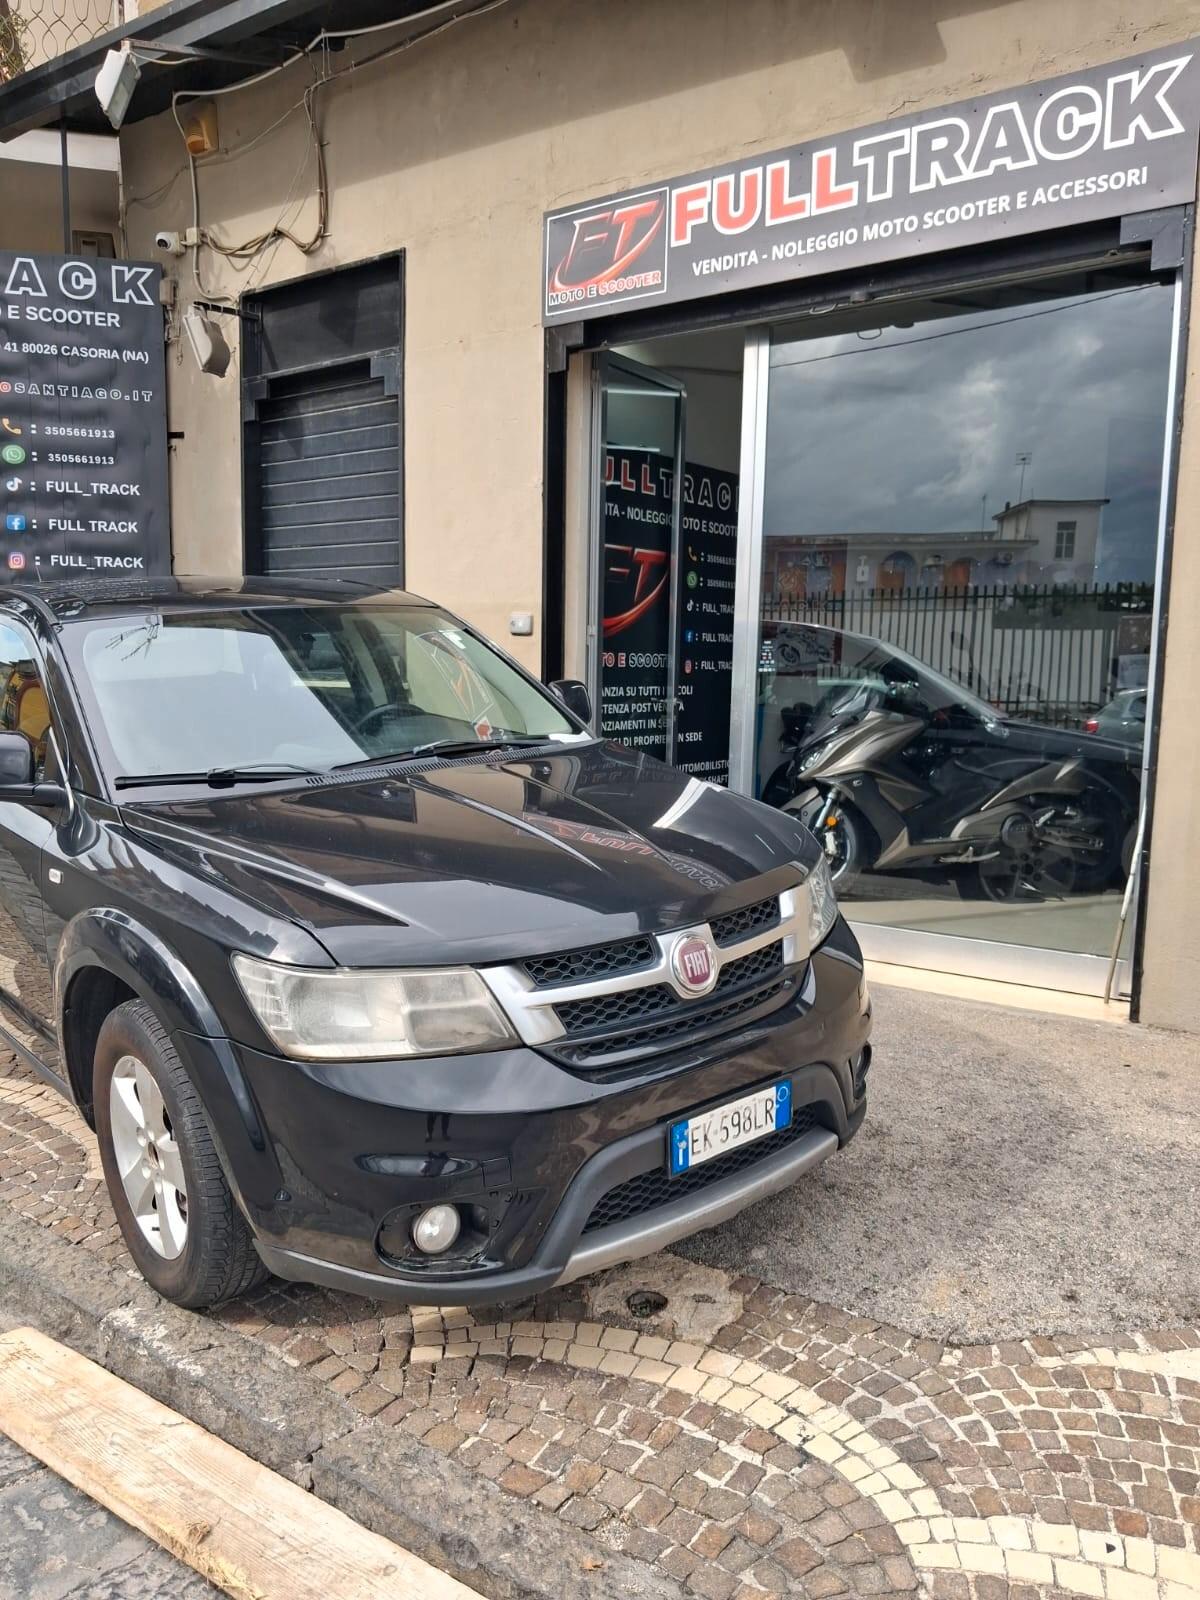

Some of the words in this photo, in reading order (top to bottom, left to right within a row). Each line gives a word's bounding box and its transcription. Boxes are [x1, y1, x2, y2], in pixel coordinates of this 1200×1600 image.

[692, 250, 758, 277] VENDITA
[772, 228, 858, 261] NOLEGGIO
[862, 215, 919, 242] MOTO
[922, 195, 1011, 229] SCOOTER
[1016, 191, 1028, 209] E
[1032, 166, 1148, 207] ACCESSORI
[4, 257, 155, 306] ACK
[548, 288, 586, 306] MOTO
[587, 284, 597, 298] E
[598, 270, 662, 296] SCOOTER
[7, 305, 20, 319] E
[25, 306, 121, 328] SCOOTER
[4, 342, 19, 353] 41
[22, 343, 58, 355] 80026
[61, 345, 120, 360] CASORIA
[122, 349, 149, 364] (NA)
[44, 426, 116, 439] 3505661913
[48, 453, 114, 465] 3505661913
[46, 480, 141, 496] FULL_TRACK
[48, 518, 85, 531] FULL
[89, 520, 138, 533] TRACK
[50, 555, 144, 569] FULL_TRACK
[618, 653, 626, 667] E
[626, 686, 637, 696] SU
[639, 686, 660, 696] TUTTI
[602, 703, 629, 714] TENZA
[631, 703, 651, 713] POST
[647, 719, 657, 729] IN
[686, 732, 703, 741] SEDE
[684, 950, 709, 978] FIAT
